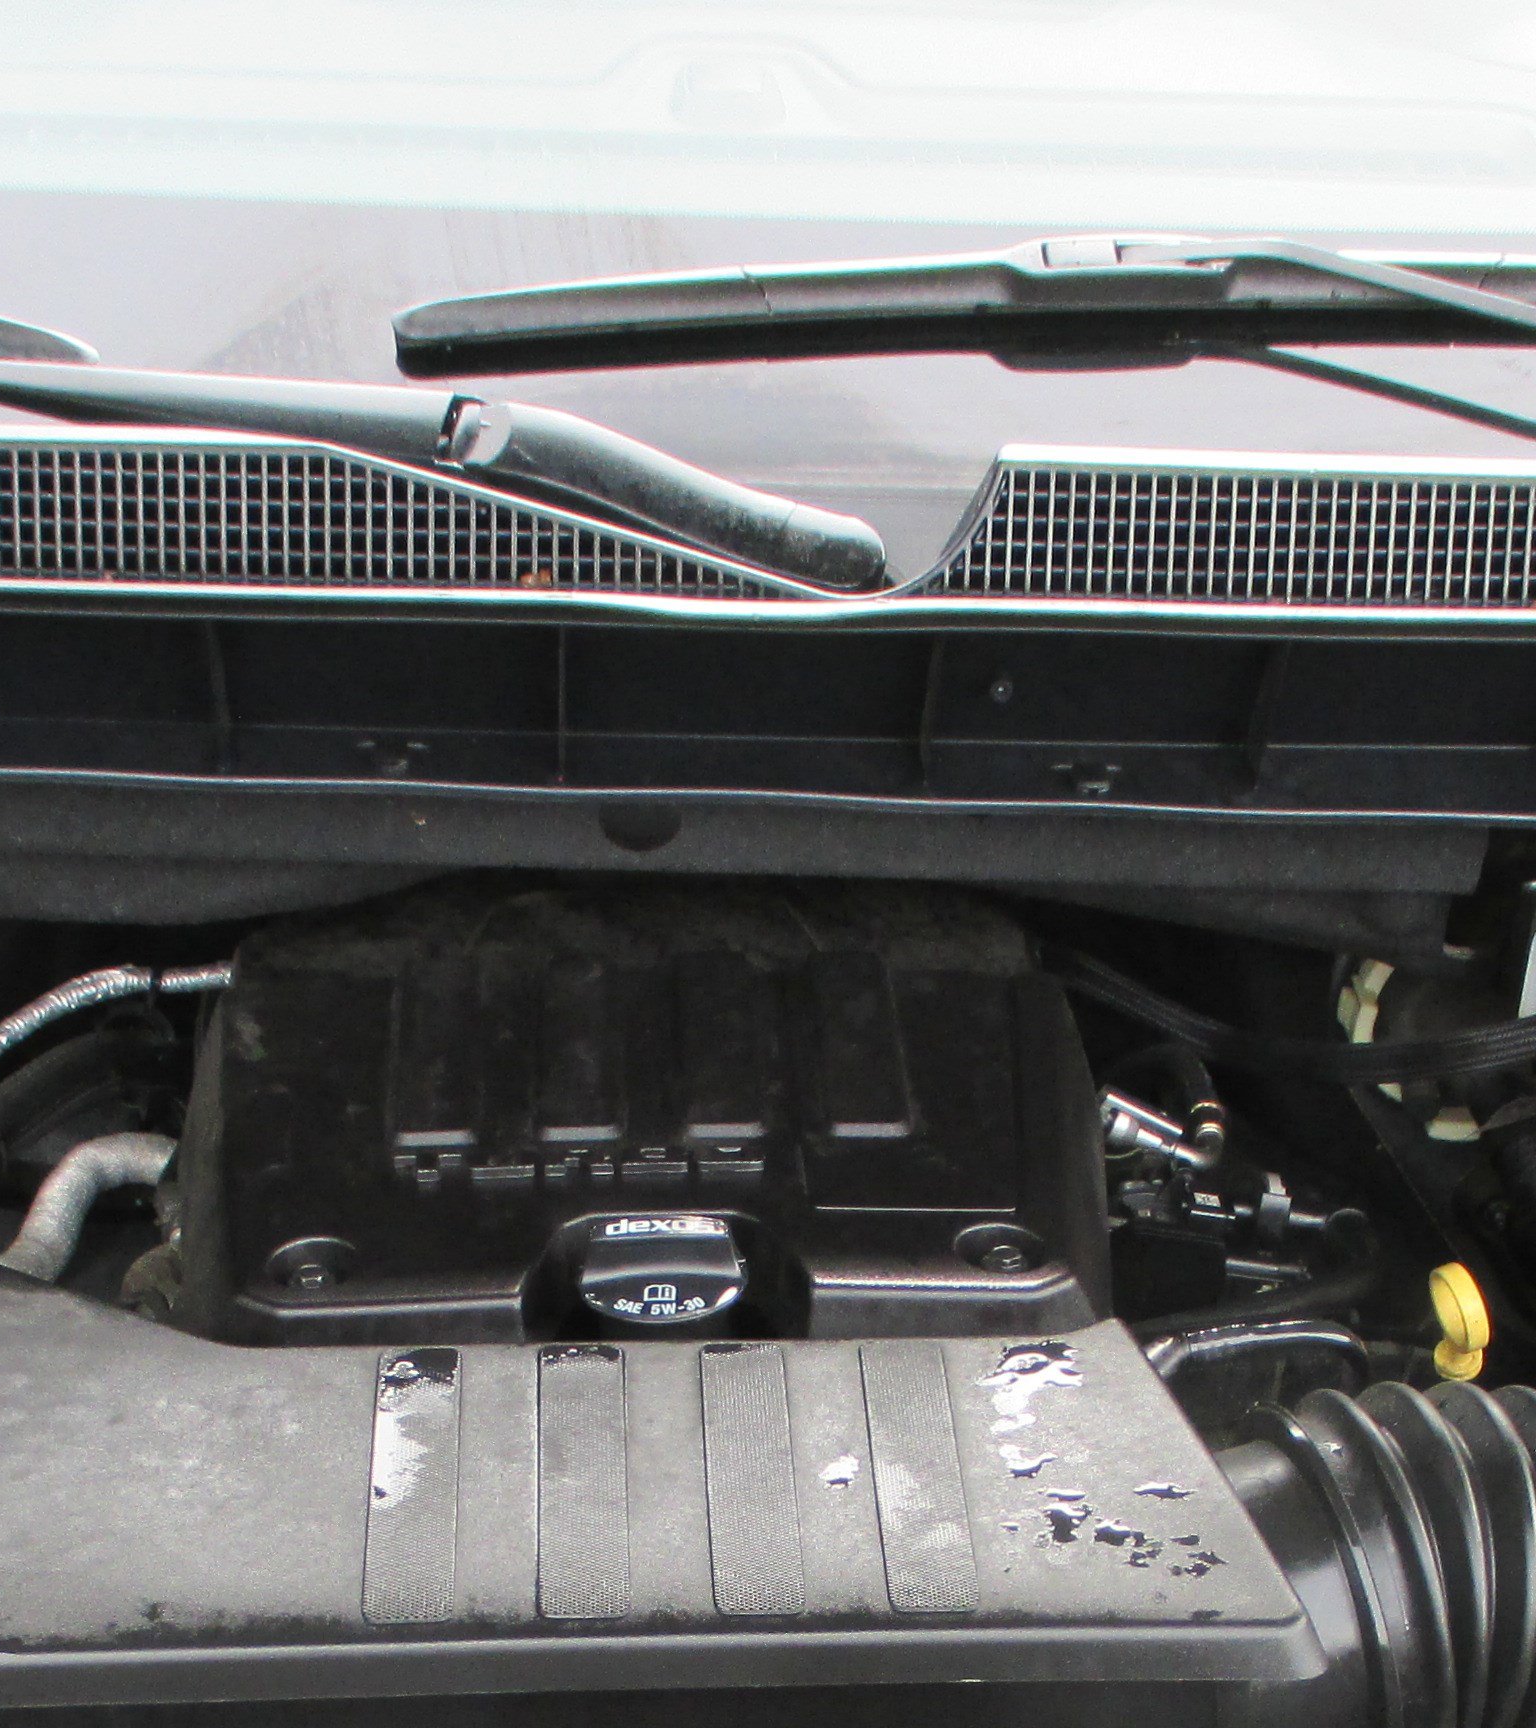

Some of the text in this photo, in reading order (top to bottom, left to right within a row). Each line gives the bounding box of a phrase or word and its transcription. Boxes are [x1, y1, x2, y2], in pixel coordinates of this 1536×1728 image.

[605, 1218, 726, 1236] dexos
[613, 1296, 706, 1316] SAE 5W-30
